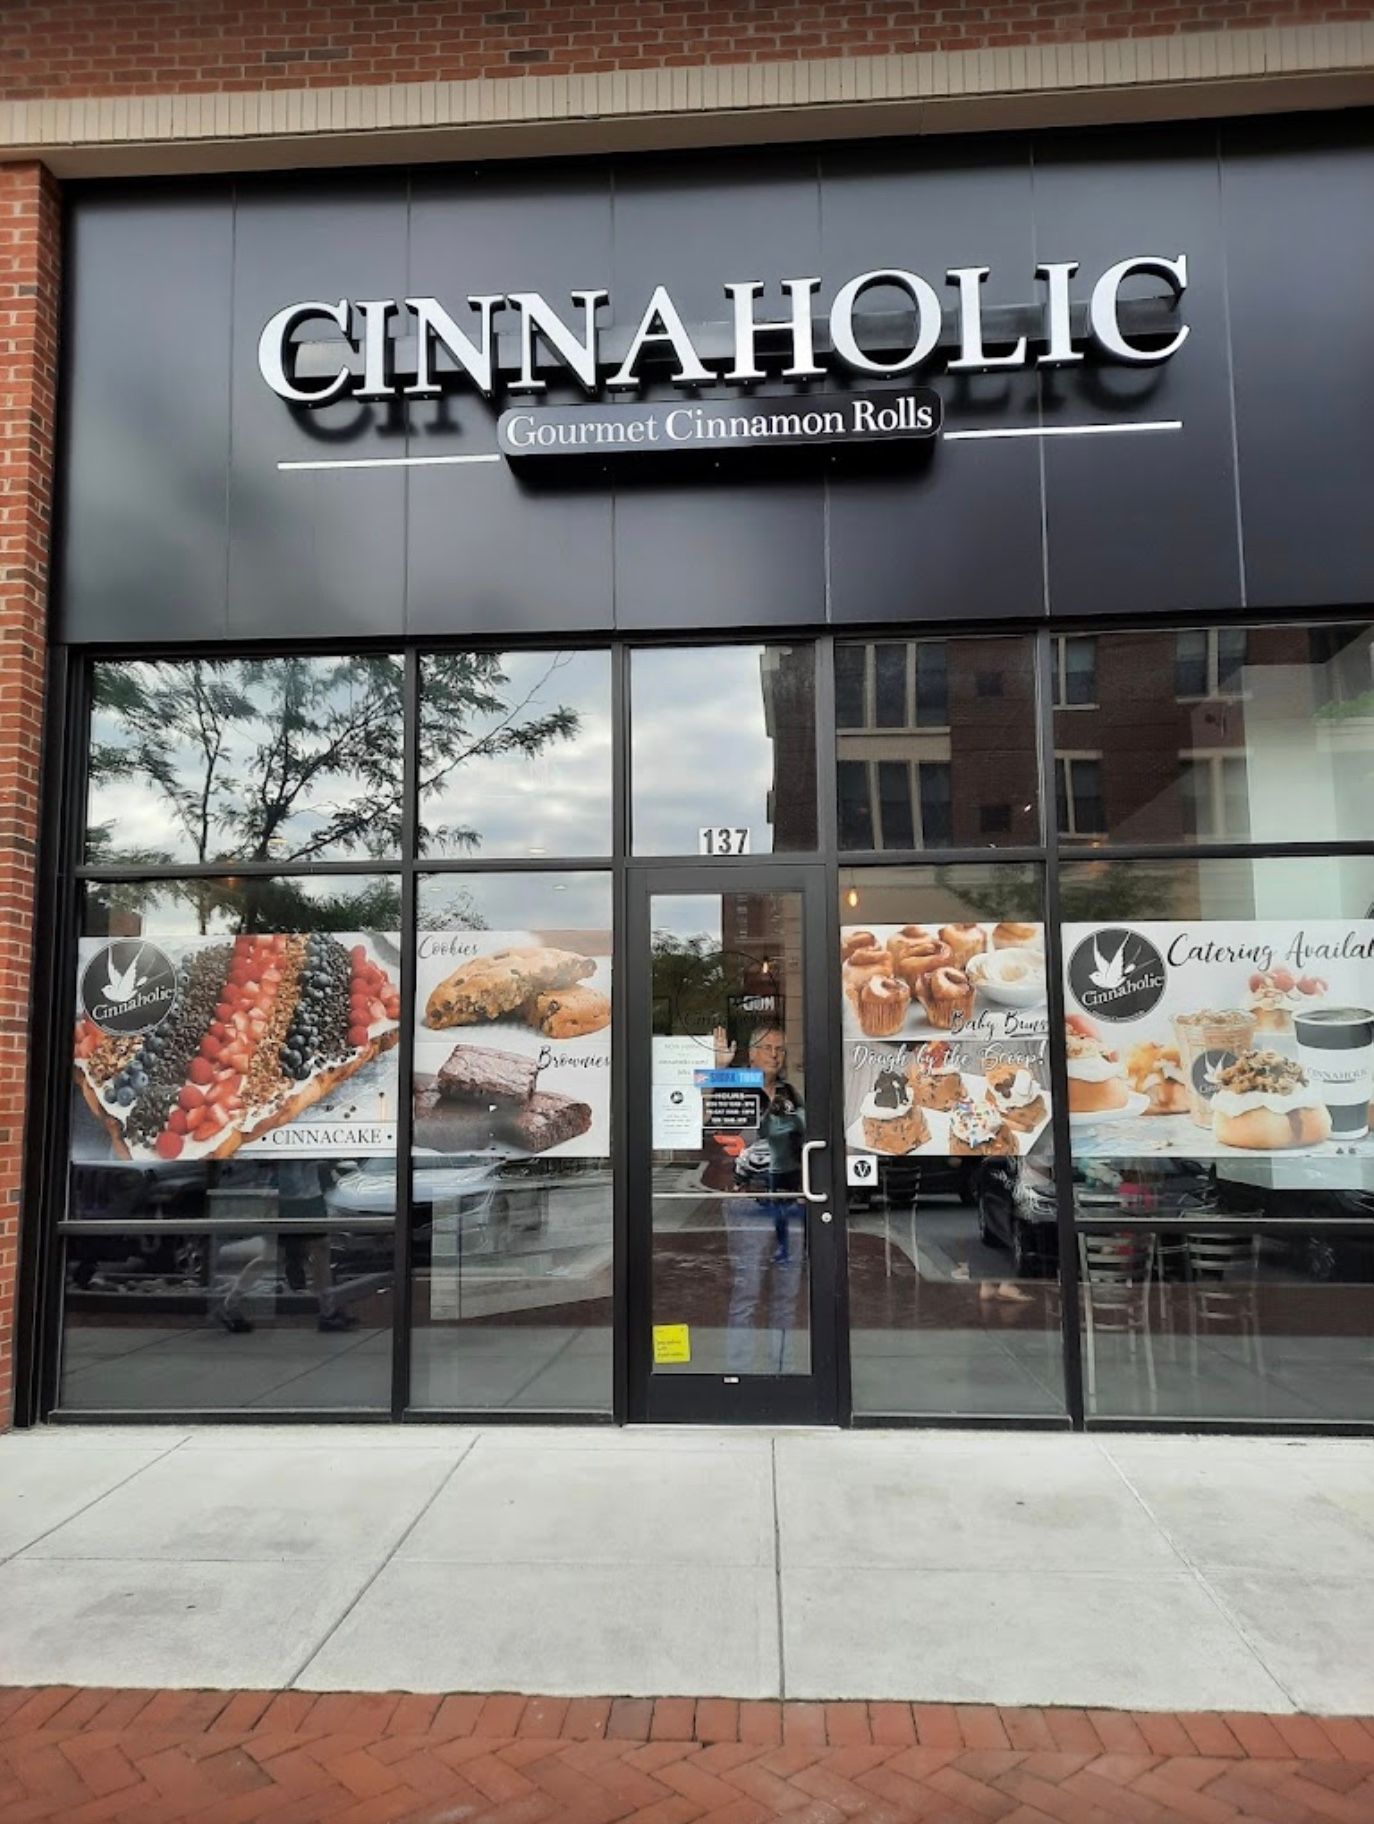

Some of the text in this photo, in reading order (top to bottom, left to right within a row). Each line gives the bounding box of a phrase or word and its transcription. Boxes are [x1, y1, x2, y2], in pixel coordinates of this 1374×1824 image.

[258, 254, 1190, 400] CINNAHOLIC
[507, 397, 932, 447] Gourmet Cinnamon Rolls
[704, 829, 748, 854] 137
[418, 935, 478, 960] Cookies
[1167, 932, 1275, 972] Catering
[92, 985, 173, 1020] Cinnaholic
[1081, 972, 1164, 1006] Cinnaholic
[951, 1008, 995, 1040] Baby
[536, 1045, 611, 1070] Brownies
[853, 1039, 1047, 1076] Dough by the Scoop!
[272, 1128, 381, 1145] CINNACAKE
